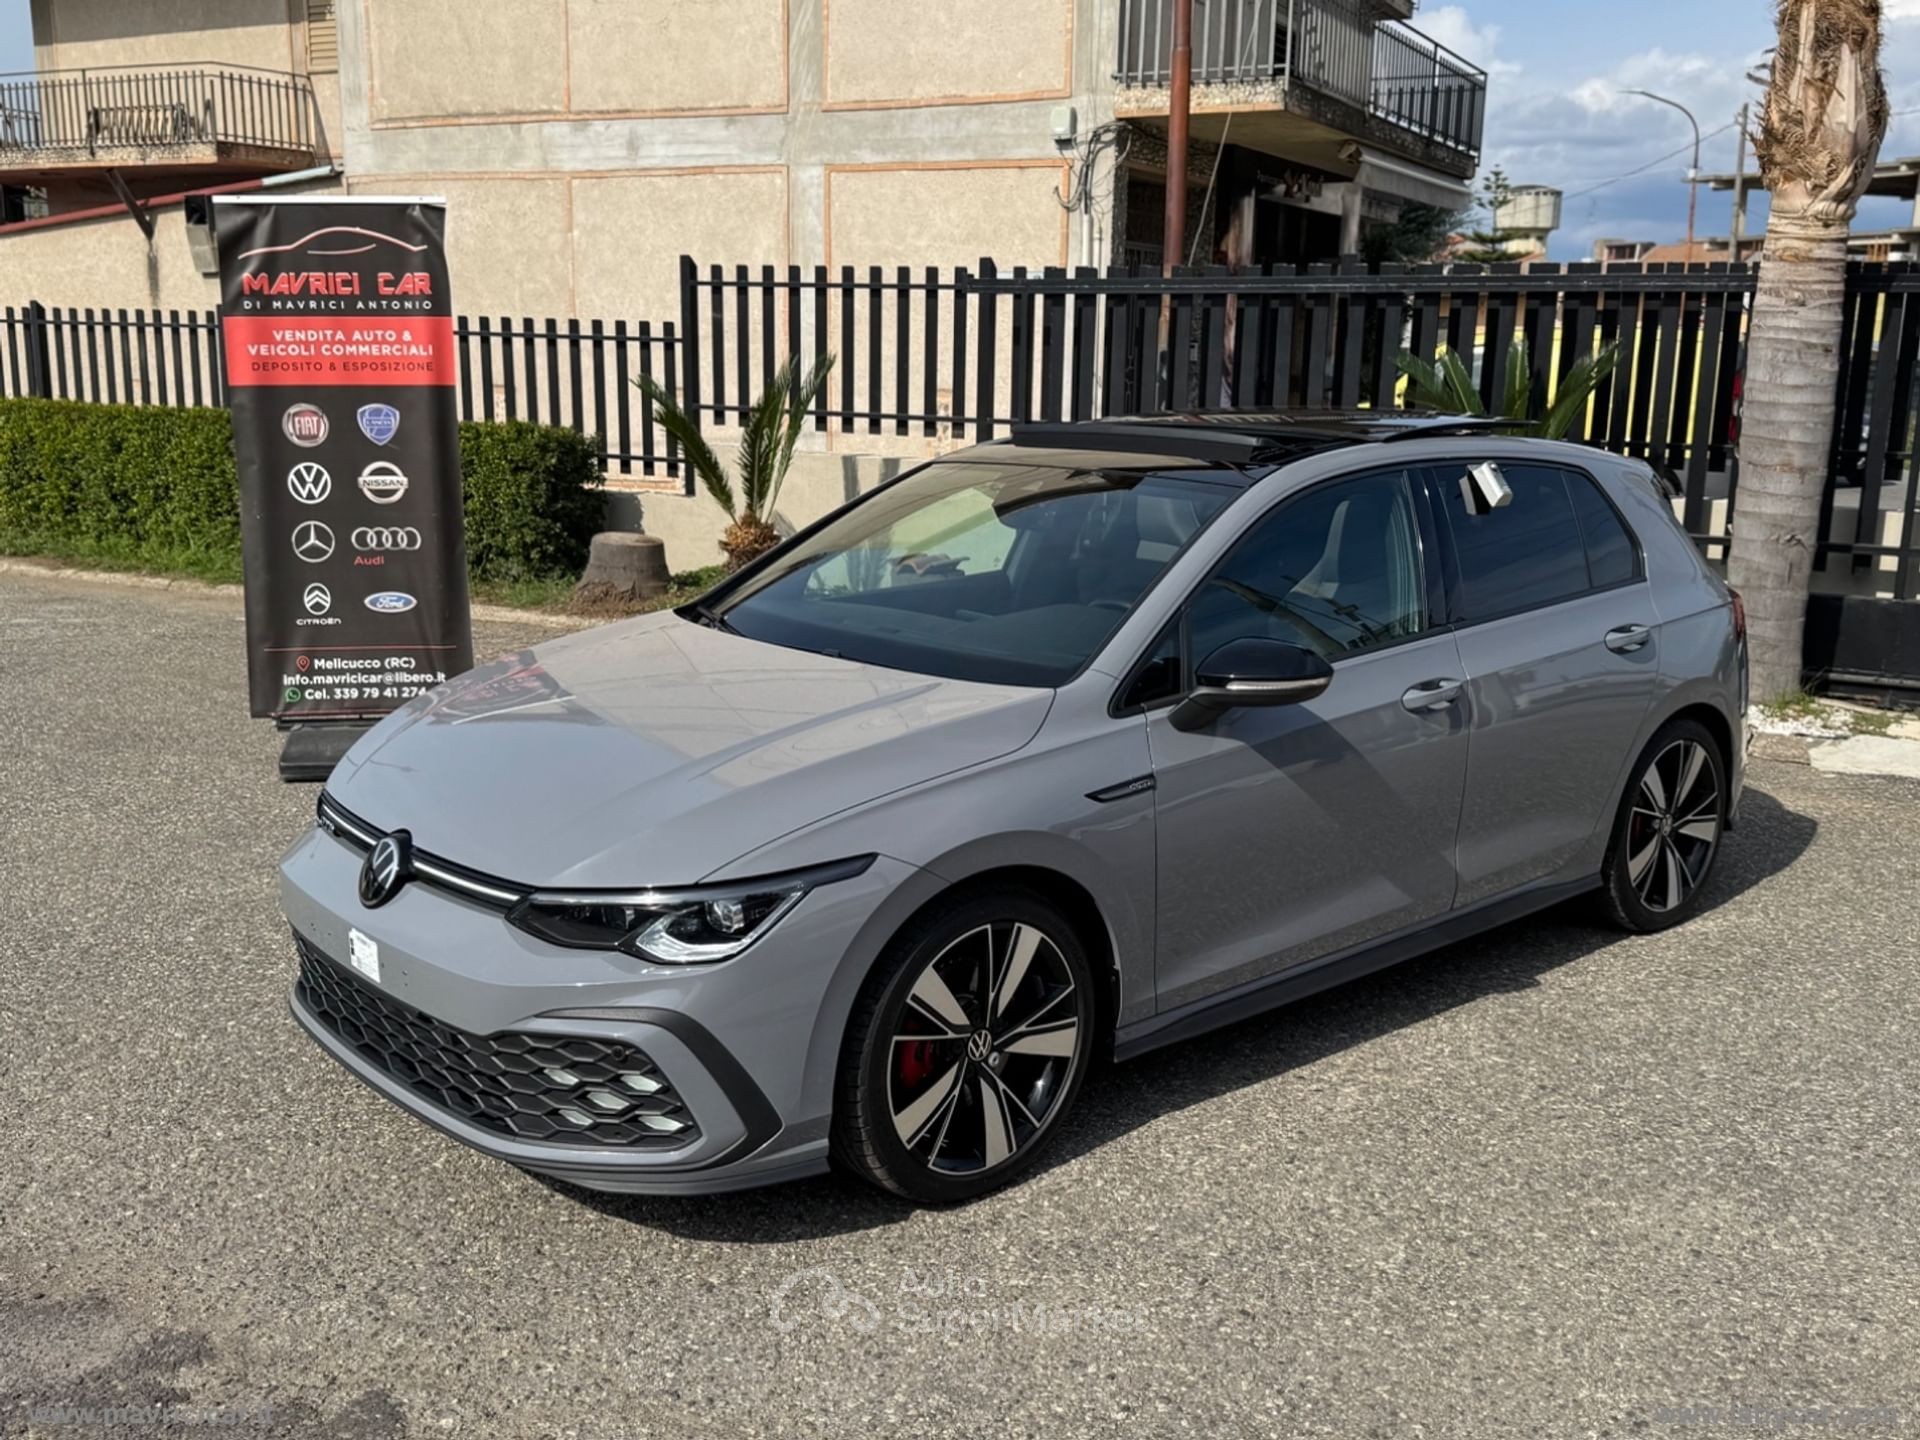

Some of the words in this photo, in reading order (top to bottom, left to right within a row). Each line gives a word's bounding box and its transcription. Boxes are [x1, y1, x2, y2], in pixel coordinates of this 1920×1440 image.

[243, 272, 360, 295] MAVRICI
[378, 272, 432, 295] CAR
[243, 300, 261, 310] DI
[272, 300, 345, 310] MAVRICI
[356, 300, 432, 310] ANTONIO
[272, 329, 346, 342] VENDITA
[352, 329, 397, 342] AUTO
[402, 330, 412, 342] &
[248, 343, 315, 357] VEICOLI
[321, 343, 433, 356] COMMERCIALI
[251, 361, 323, 372] DEPOSITO
[329, 361, 336, 372] &
[343, 361, 434, 372] ESPOSIZIONE
[295, 415, 319, 436] FIAT
[362, 478, 405, 487] NISSAN
[353, 555, 385, 566] Audi
[313, 658, 381, 670] Melicucco
[384, 657, 416, 670] (RC)
[283, 672, 447, 686] info.mavricicar@libero.it
[304, 687, 330, 700] Cel.
[334, 687, 359, 700] 339
[362, 687, 380, 699] 79
[383, 687, 398, 699] 41
